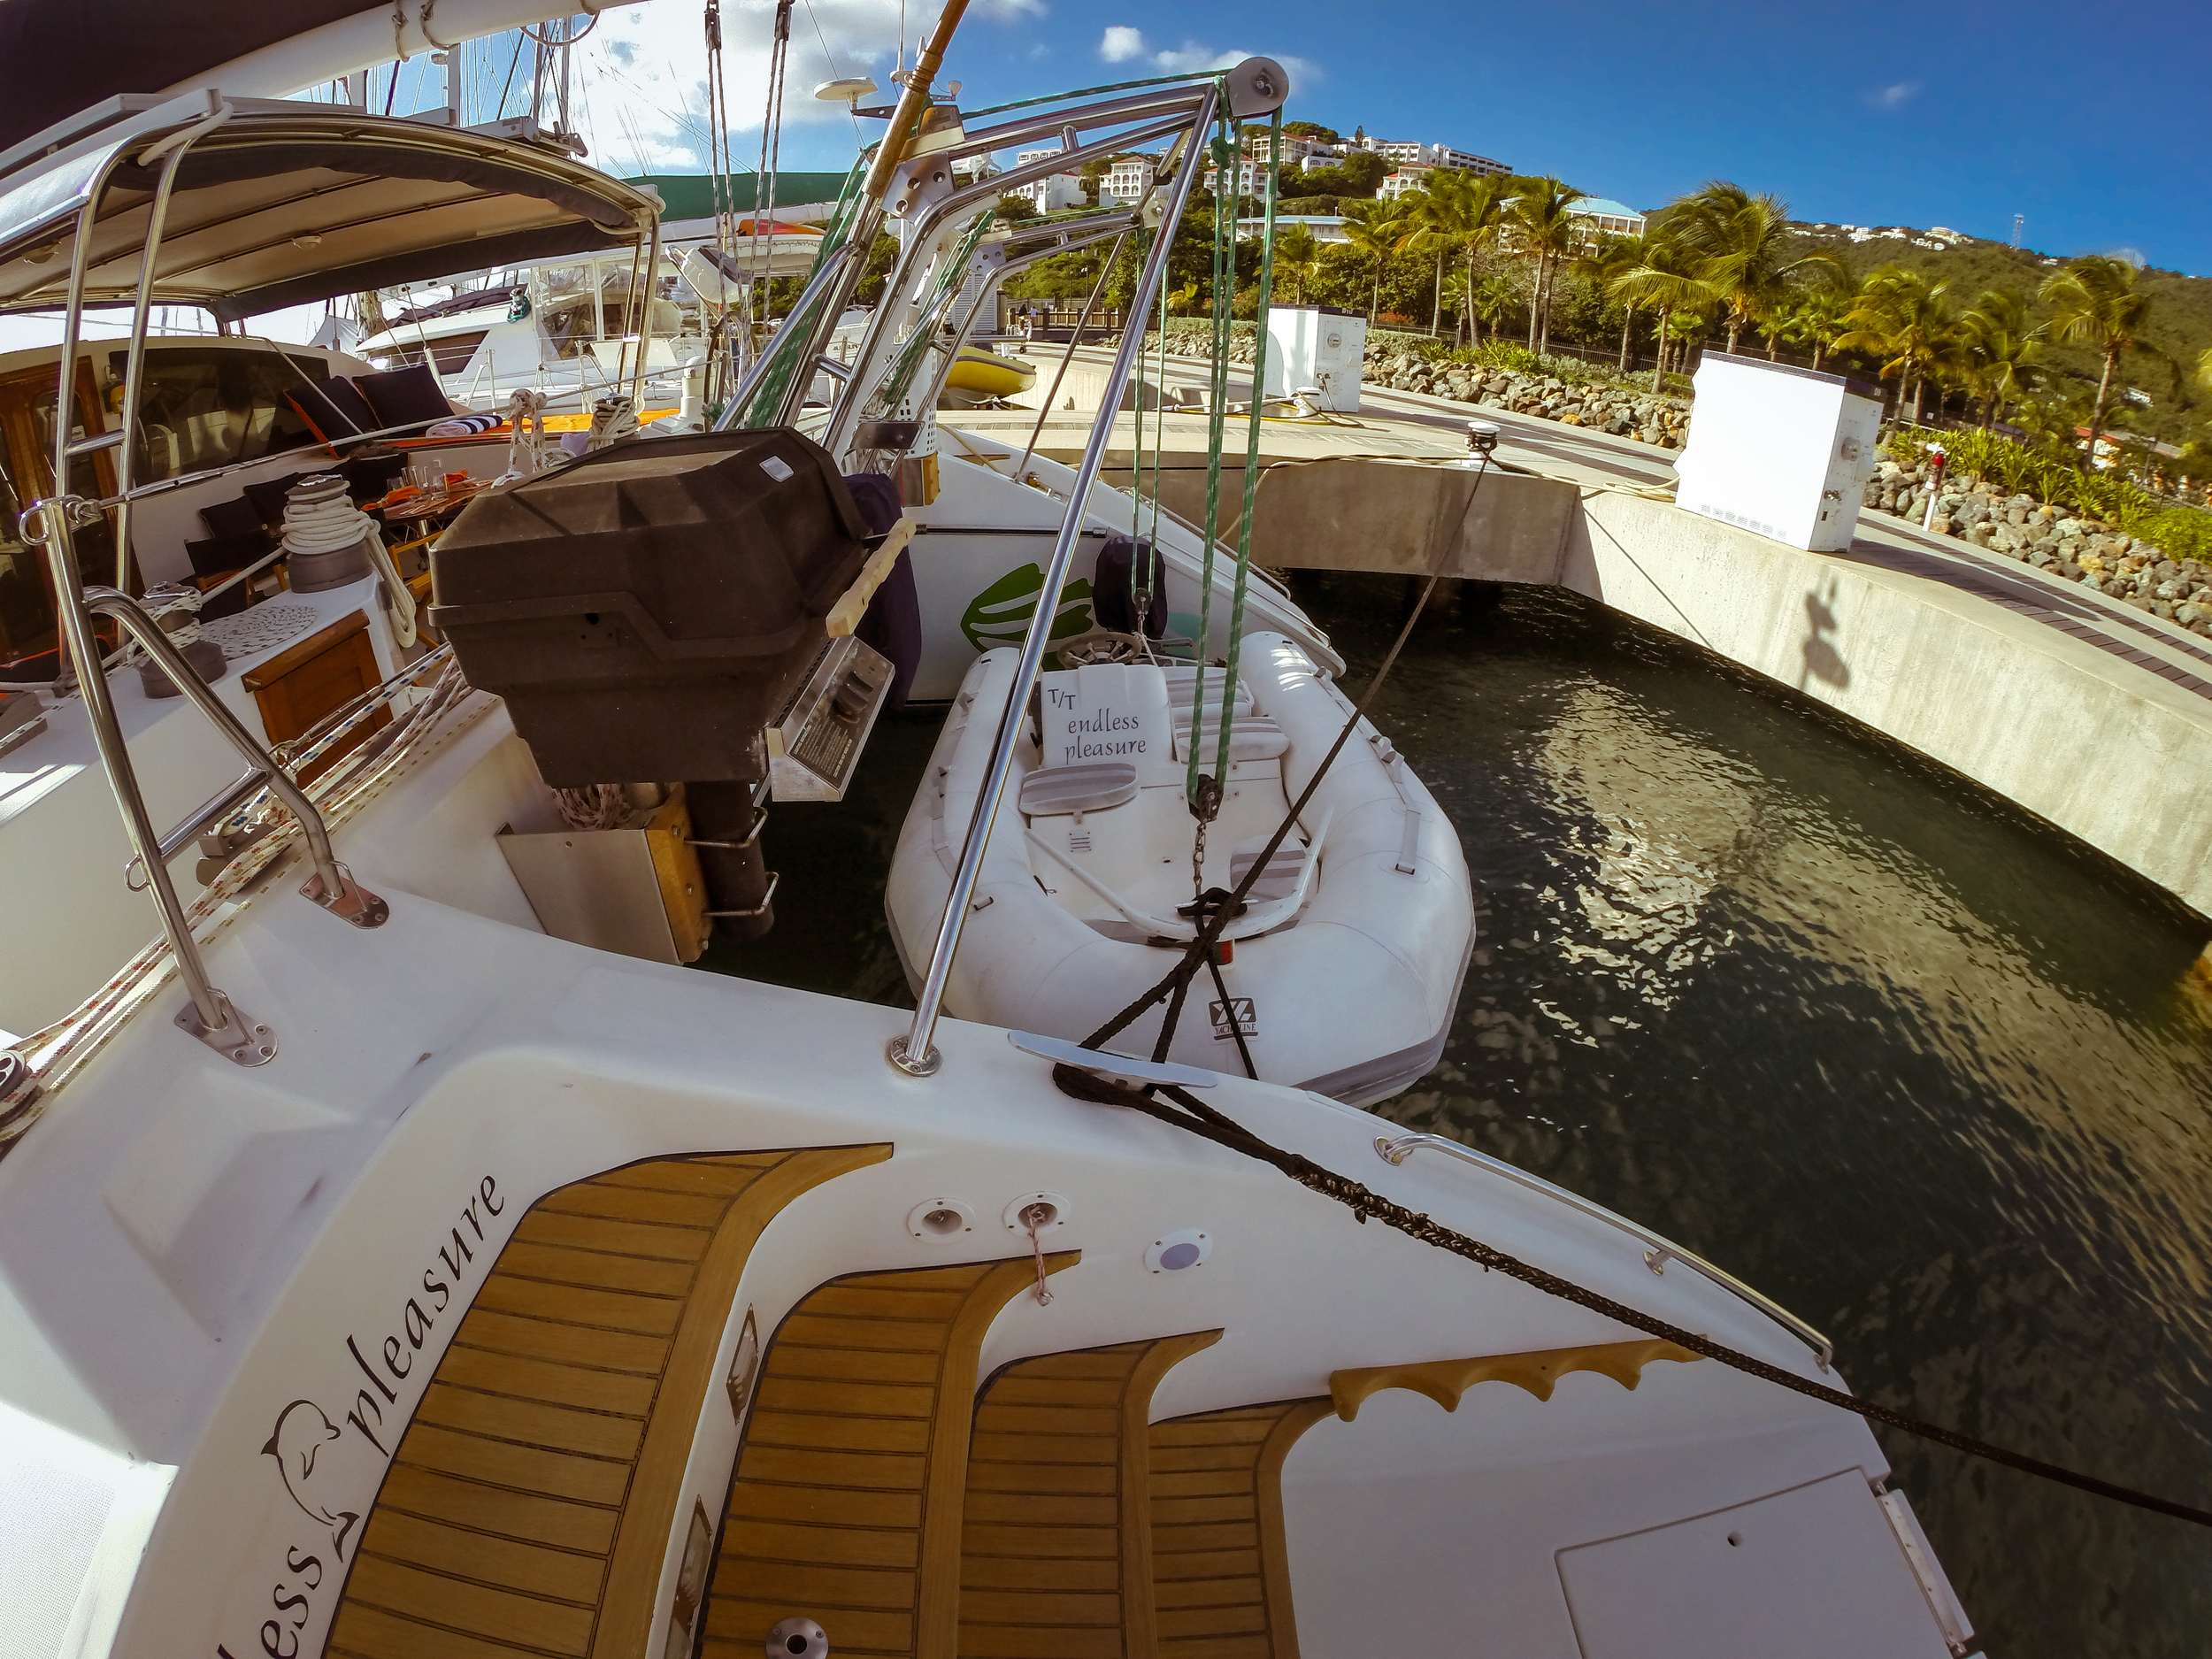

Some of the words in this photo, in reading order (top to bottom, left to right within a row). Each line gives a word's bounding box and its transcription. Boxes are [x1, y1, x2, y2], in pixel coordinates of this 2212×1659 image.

[1048, 688, 1076, 710] T/T
[1068, 708, 1140, 733] endless
[1064, 735, 1147, 765] pleasure
[1215, 1023, 1256, 1035] YACHLINE
[346, 1175, 504, 1458] pleasure
